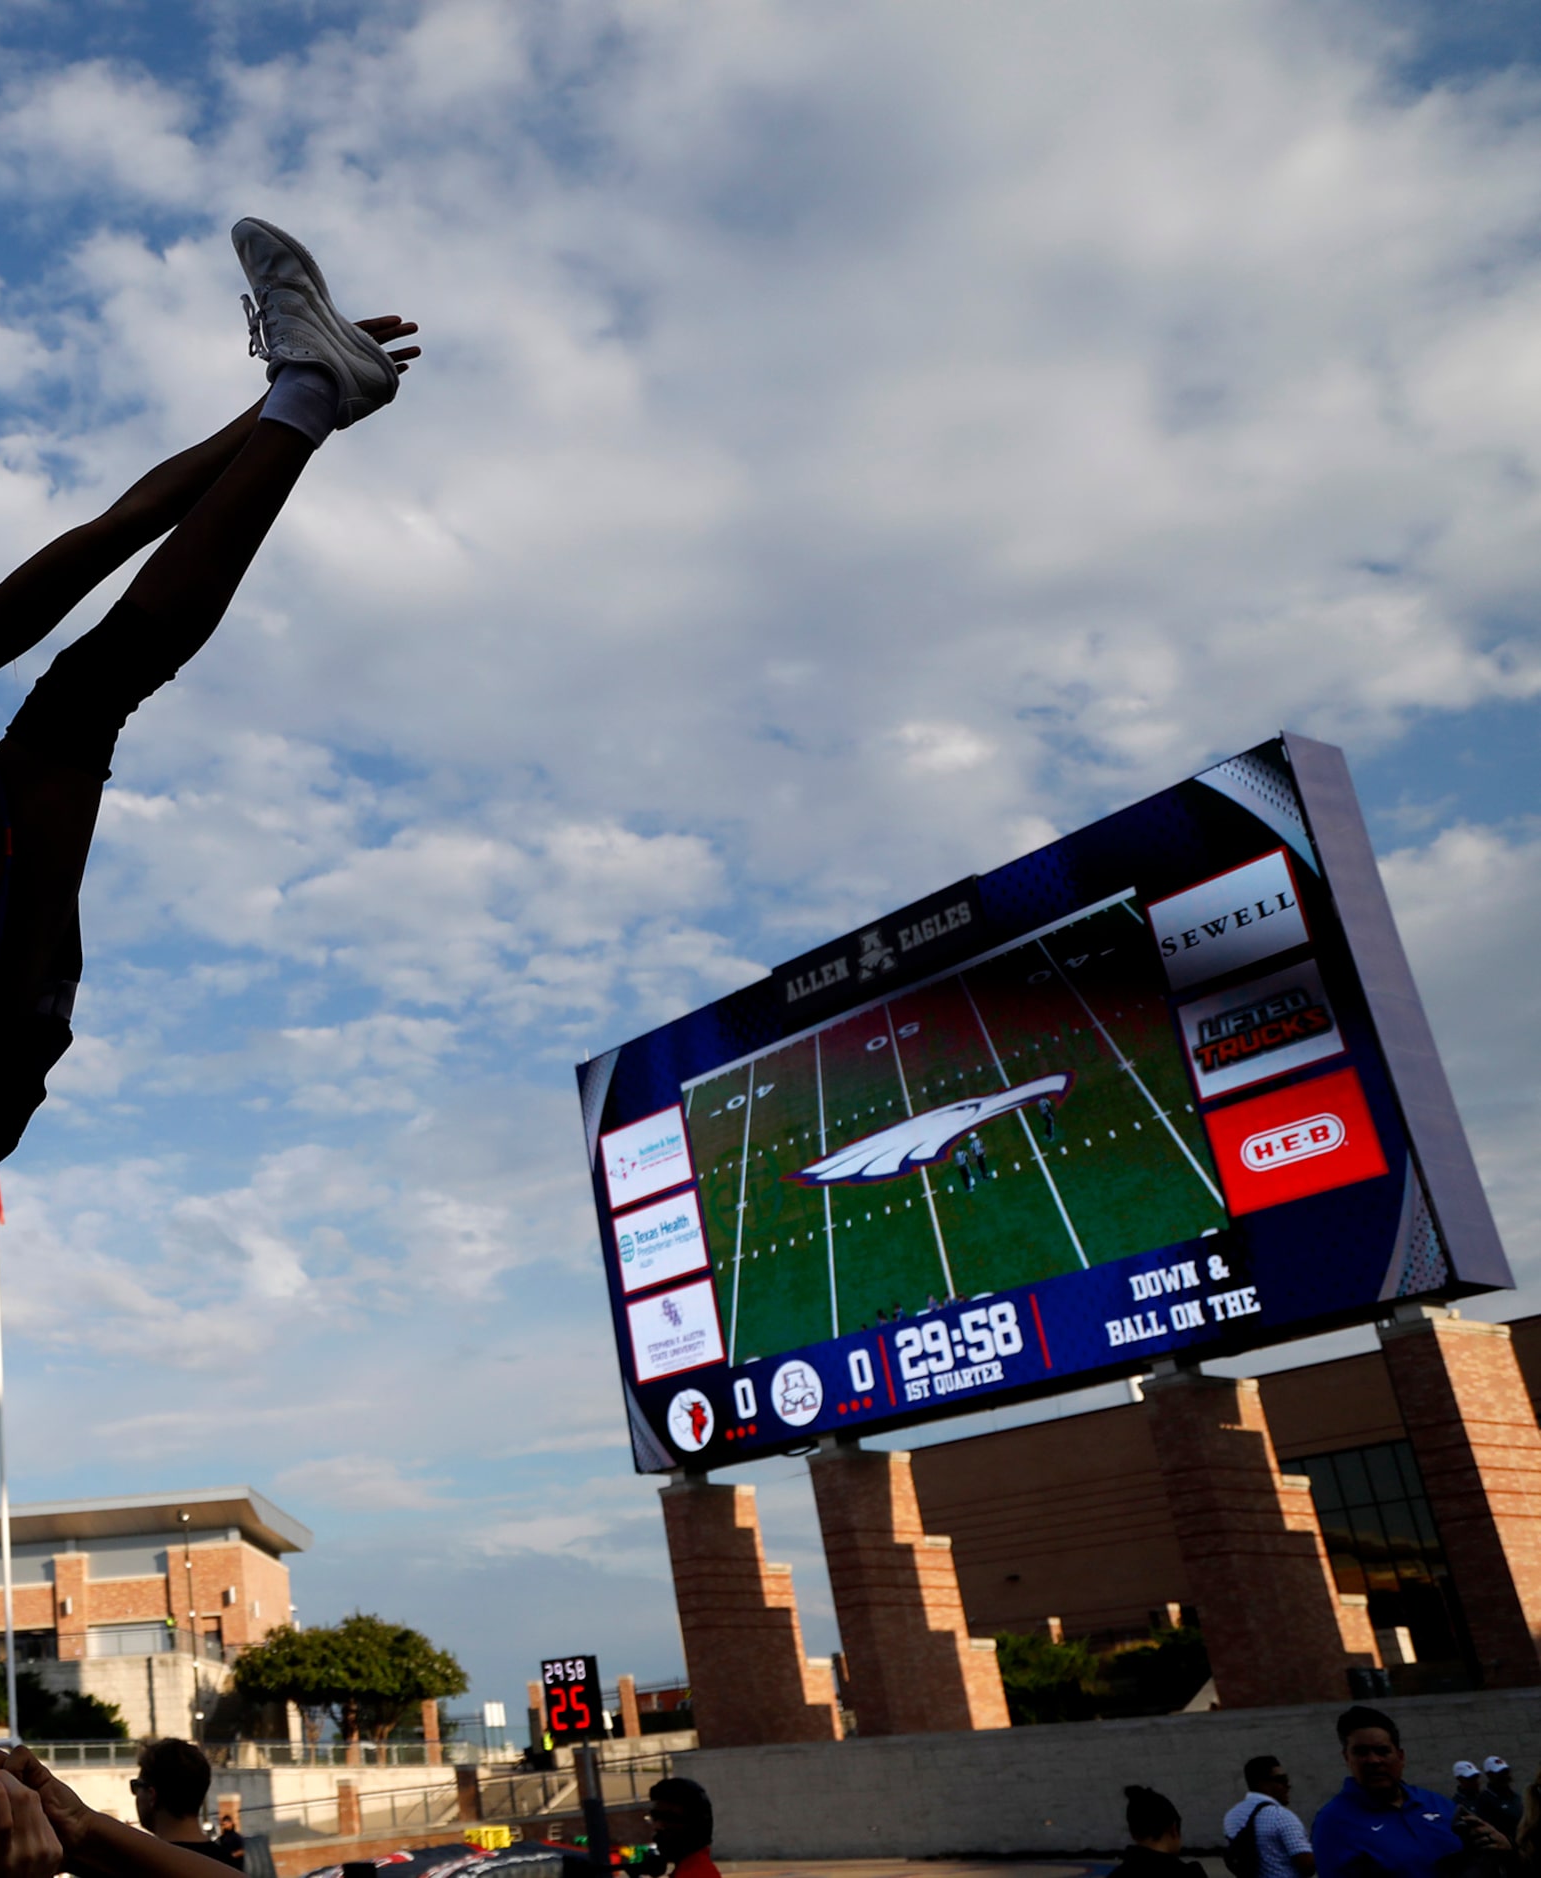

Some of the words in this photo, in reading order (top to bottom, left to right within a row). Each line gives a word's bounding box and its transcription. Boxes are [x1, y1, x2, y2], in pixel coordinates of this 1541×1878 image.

[1161, 892, 1296, 957] SEWELL
[787, 957, 850, 1003] ALLEN
[898, 901, 972, 952] EAGLES
[1194, 1007, 1331, 1070] TRUCKS
[1200, 991, 1309, 1043] LIFTED
[634, 1228, 659, 1244] Texas
[659, 1214, 690, 1236] Health
[1128, 1260, 1200, 1302] DOWN
[1207, 1254, 1230, 1281] &
[895, 1301, 1023, 1381] 29:58
[1104, 1310, 1168, 1347] BALL
[1169, 1299, 1205, 1331] ON
[1206, 1285, 1261, 1321] THE
[848, 1348, 875, 1392] 0
[904, 1377, 930, 1402] 1ST
[932, 1360, 1005, 1396] QUARTER
[733, 1377, 758, 1419] 0
[549, 1685, 591, 1731] 25
